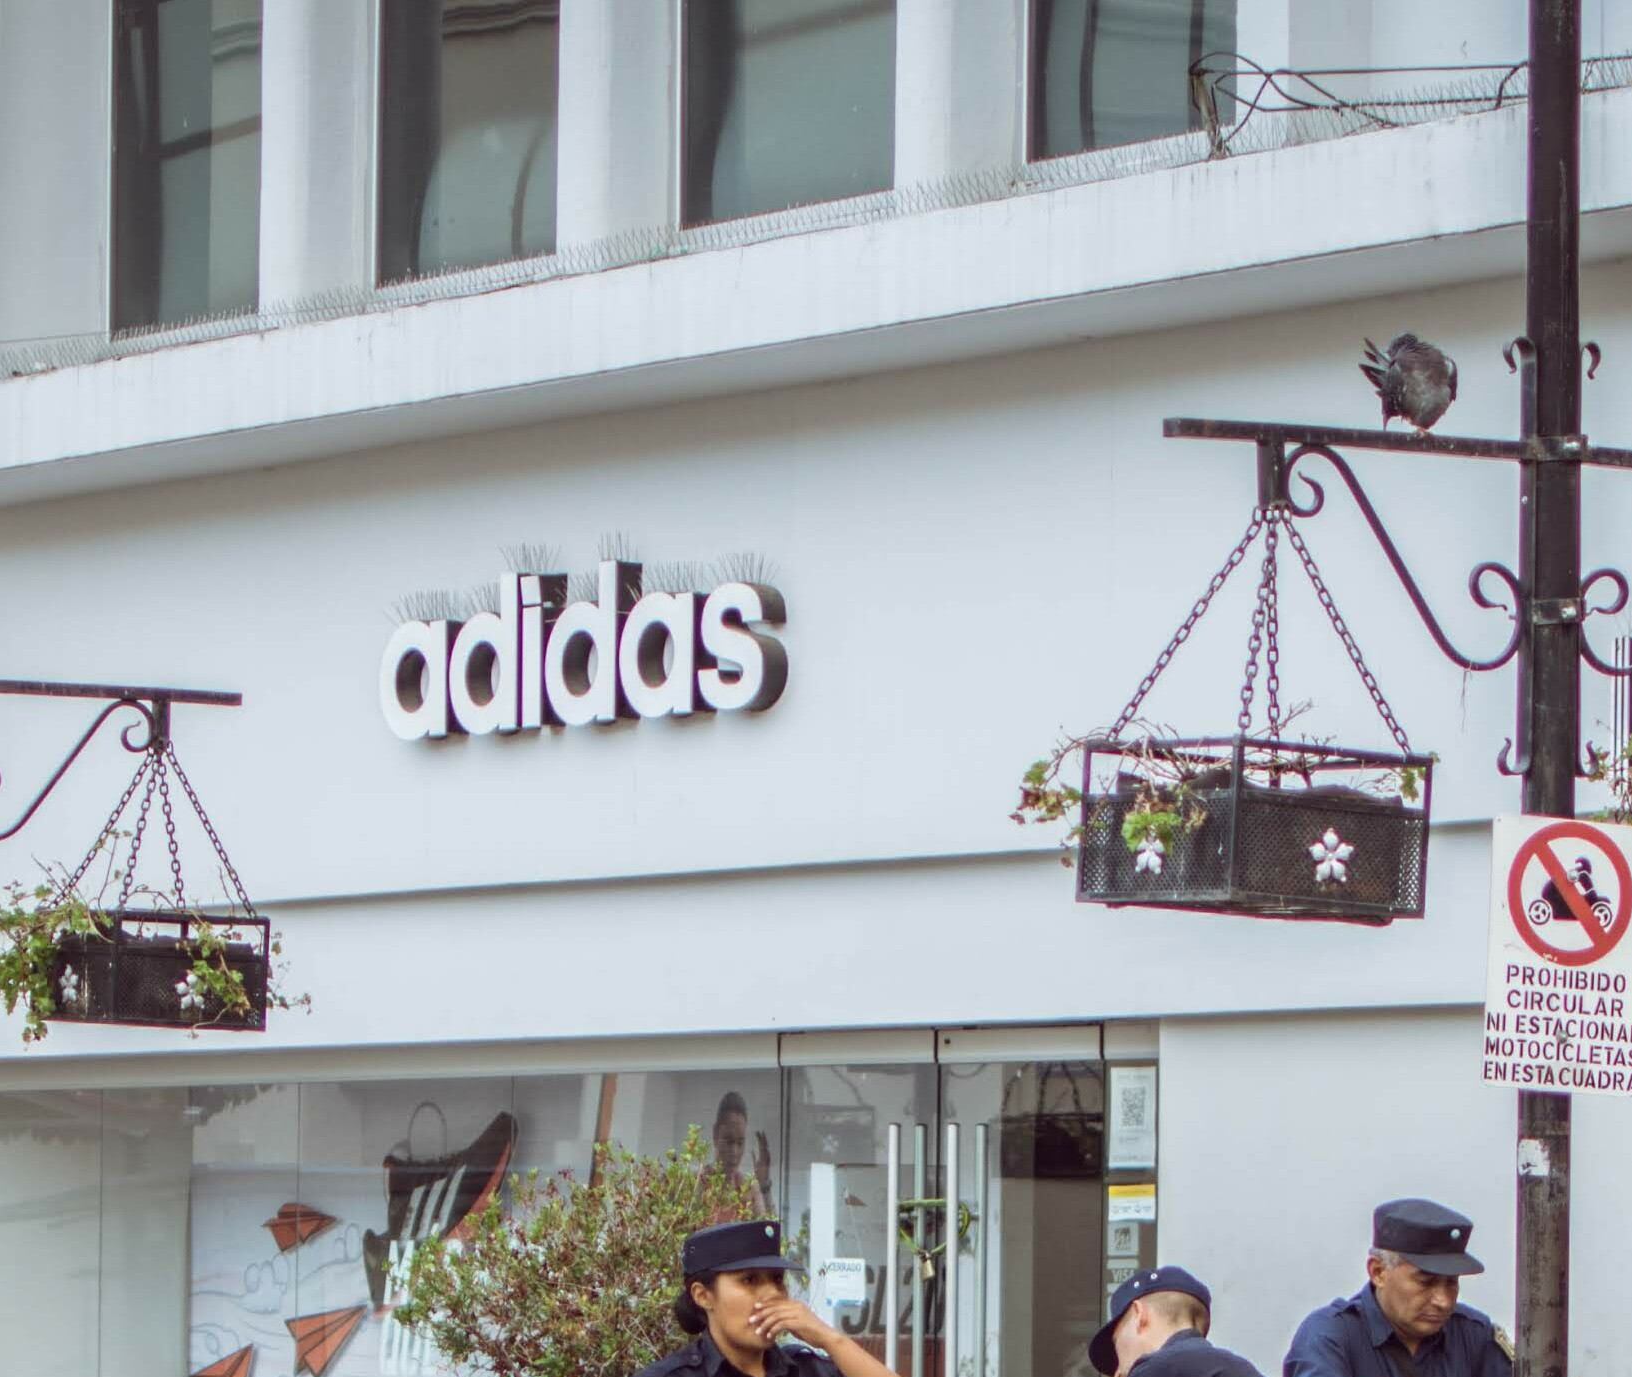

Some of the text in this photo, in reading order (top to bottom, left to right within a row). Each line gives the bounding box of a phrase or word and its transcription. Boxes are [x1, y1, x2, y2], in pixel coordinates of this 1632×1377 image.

[379, 560, 788, 741] adidas
[1506, 964, 1627, 993] PROHIBIDO
[1507, 989, 1624, 1018] CIRCULAR
[1486, 1012, 1507, 1032] NI
[1483, 1061, 1507, 1081] EN
[1511, 1063, 1555, 1086] ESTA
